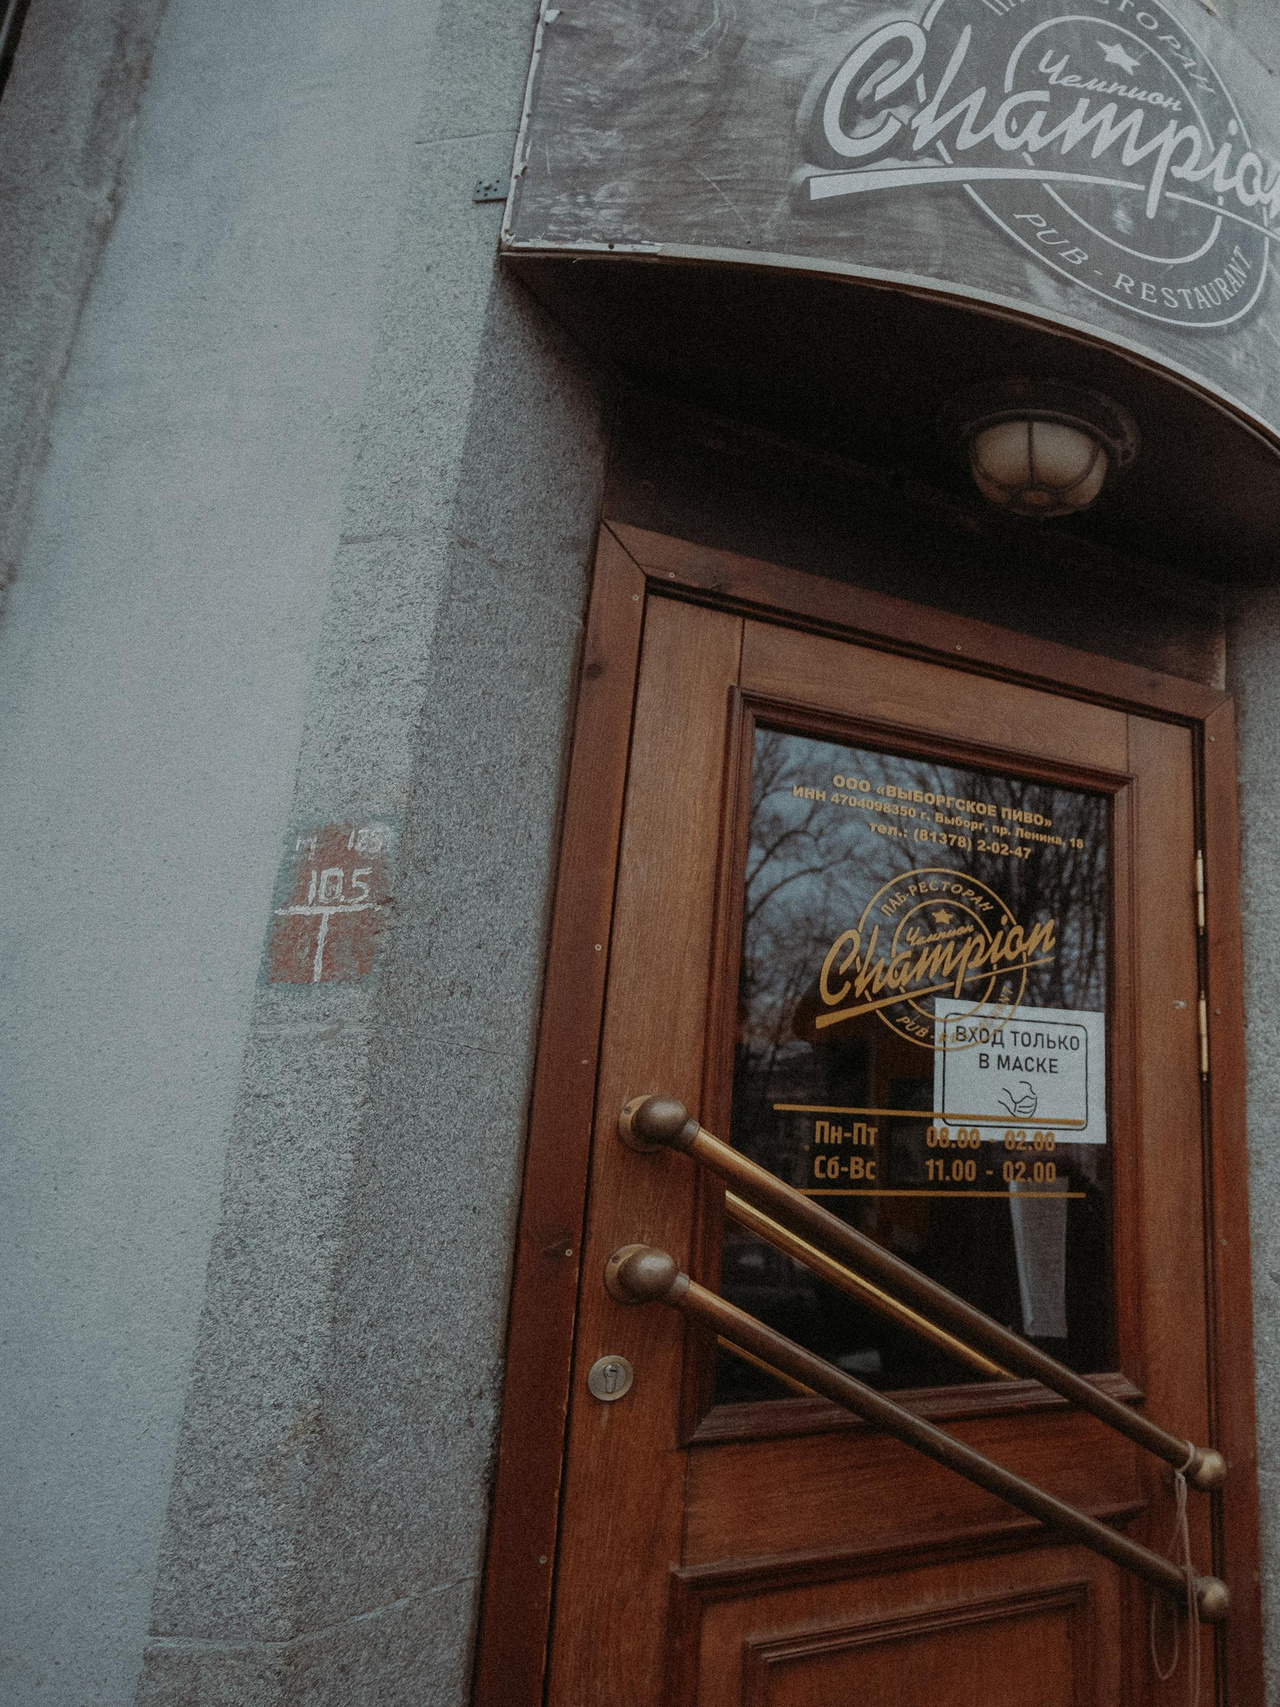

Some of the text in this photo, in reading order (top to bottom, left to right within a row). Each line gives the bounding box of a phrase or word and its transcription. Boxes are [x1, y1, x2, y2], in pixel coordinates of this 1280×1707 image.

[1038, 49, 1183, 112] Чемпион
[1013, 213, 1090, 266] PUB
[1112, 244, 1252, 310] RESTAURANT
[792, 784, 1084, 850] ИНН 4704098350 г. Выборг, пр. Ленина, 18
[832, 774, 1052, 828] ООО «ВЫБОРГСКОЕ ПИВО»
[913, 827, 973, 853] (81378)
[976, 838, 1032, 860] 2-02-47
[880, 880, 995, 918] ПАБ-РЕСТОРАН
[905, 924, 975, 947] Чемпион
[819, 915, 1056, 1006] Champion
[896, 1016, 929, 1038] PUB
[955, 1025, 1080, 1051] ВХОД ТОЛЬКО
[978, 1053, 1059, 1074] В МАСКЕ
[814, 1120, 879, 1146] Пн-Пт
[926, 1125, 981, 1149] 08.00
[1004, 1129, 1057, 1151] 02.00
[814, 1155, 877, 1180] Сб-Вс
[925, 1158, 977, 1182] 11.00
[1002, 1160, 1057, 1183] 02.00
